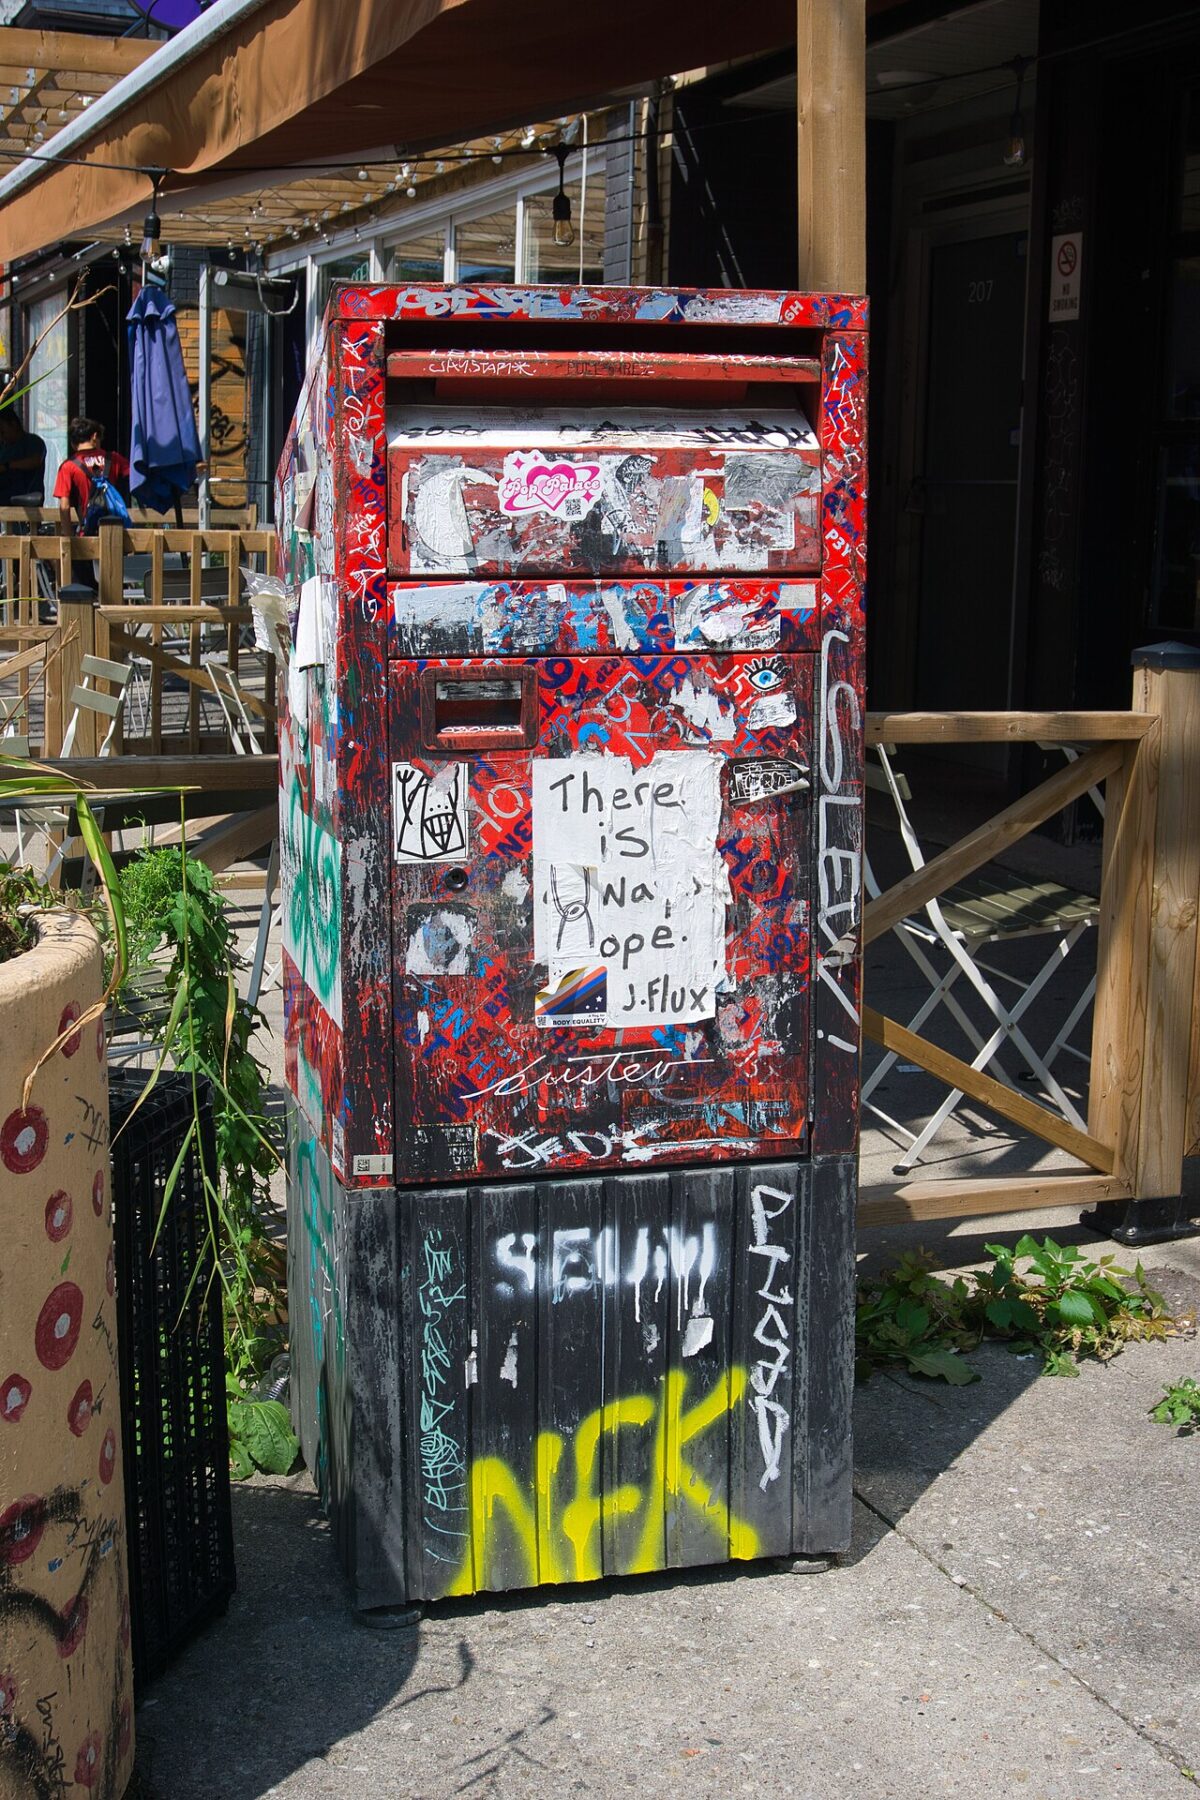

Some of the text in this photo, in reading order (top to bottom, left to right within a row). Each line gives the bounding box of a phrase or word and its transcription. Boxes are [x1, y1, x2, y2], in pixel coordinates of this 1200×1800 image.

[967, 279, 994, 304] 207
[1061, 283, 1070, 295] NO
[1052, 297, 1078, 311] SMOKING
[504, 474, 601, 499] Pop Palace
[825, 528, 851, 560] P3Y
[549, 770, 684, 814] There
[621, 973, 709, 1014] J.Flux
[572, 1017, 606, 1026] EQUALITY
